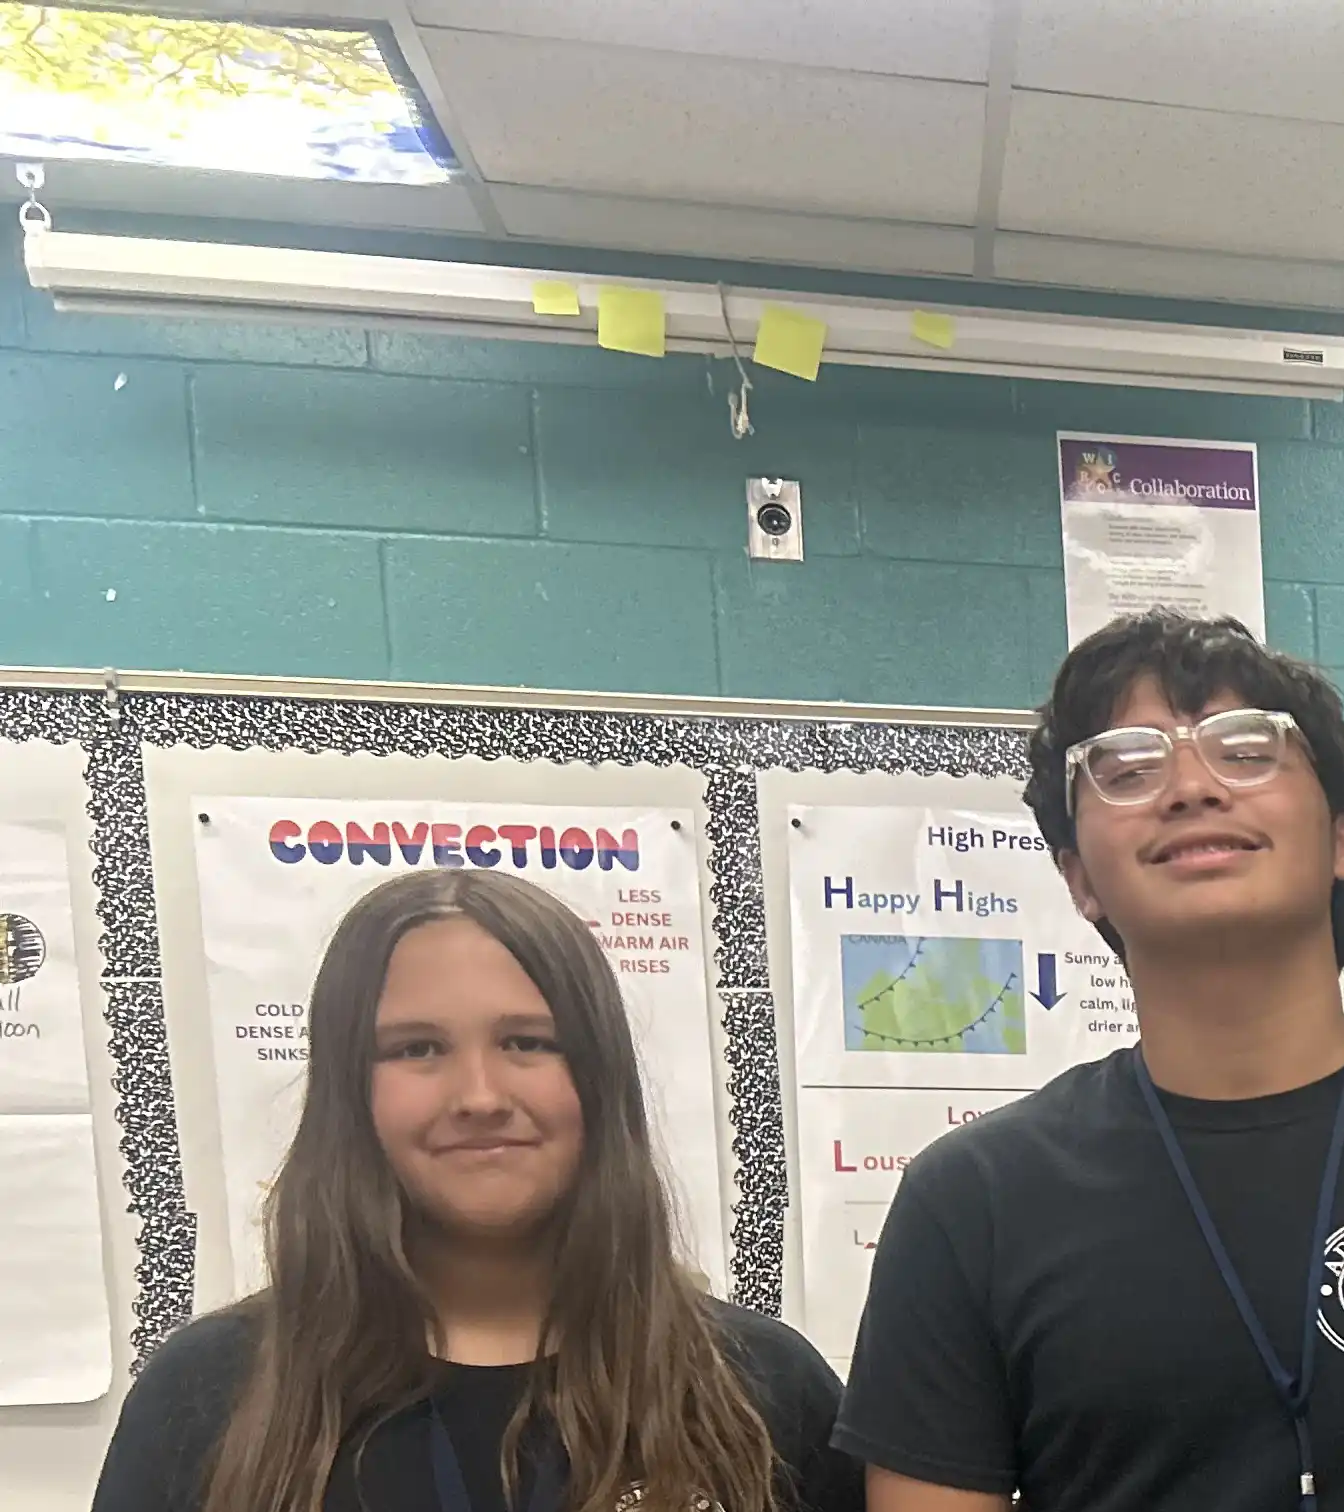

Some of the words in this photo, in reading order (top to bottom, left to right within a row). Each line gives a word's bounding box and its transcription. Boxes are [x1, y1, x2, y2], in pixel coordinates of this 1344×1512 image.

[1130, 478, 1251, 501] Collaboration
[269, 820, 640, 871] CONVECTION
[928, 826, 984, 852] High
[992, 830, 1051, 851] Pres
[618, 890, 662, 903] LESS
[824, 876, 920, 914] Happy
[934, 879, 1018, 917] Highs
[612, 912, 672, 927] DENSE
[659, 937, 689, 950] AIR
[620, 960, 671, 973] RISES
[1065, 952, 1109, 968] Sunny
[1091, 975, 1116, 987] low
[256, 1004, 304, 1016] COLD
[1080, 998, 1118, 1013] calm,
[0, 1022, 40, 1039] oon
[236, 1026, 294, 1038] DENSE
[1088, 1020, 1122, 1032] drier
[258, 1048, 309, 1060] SINKS
[948, 1106, 988, 1125] Lo
[834, 1140, 912, 1172] Lous
